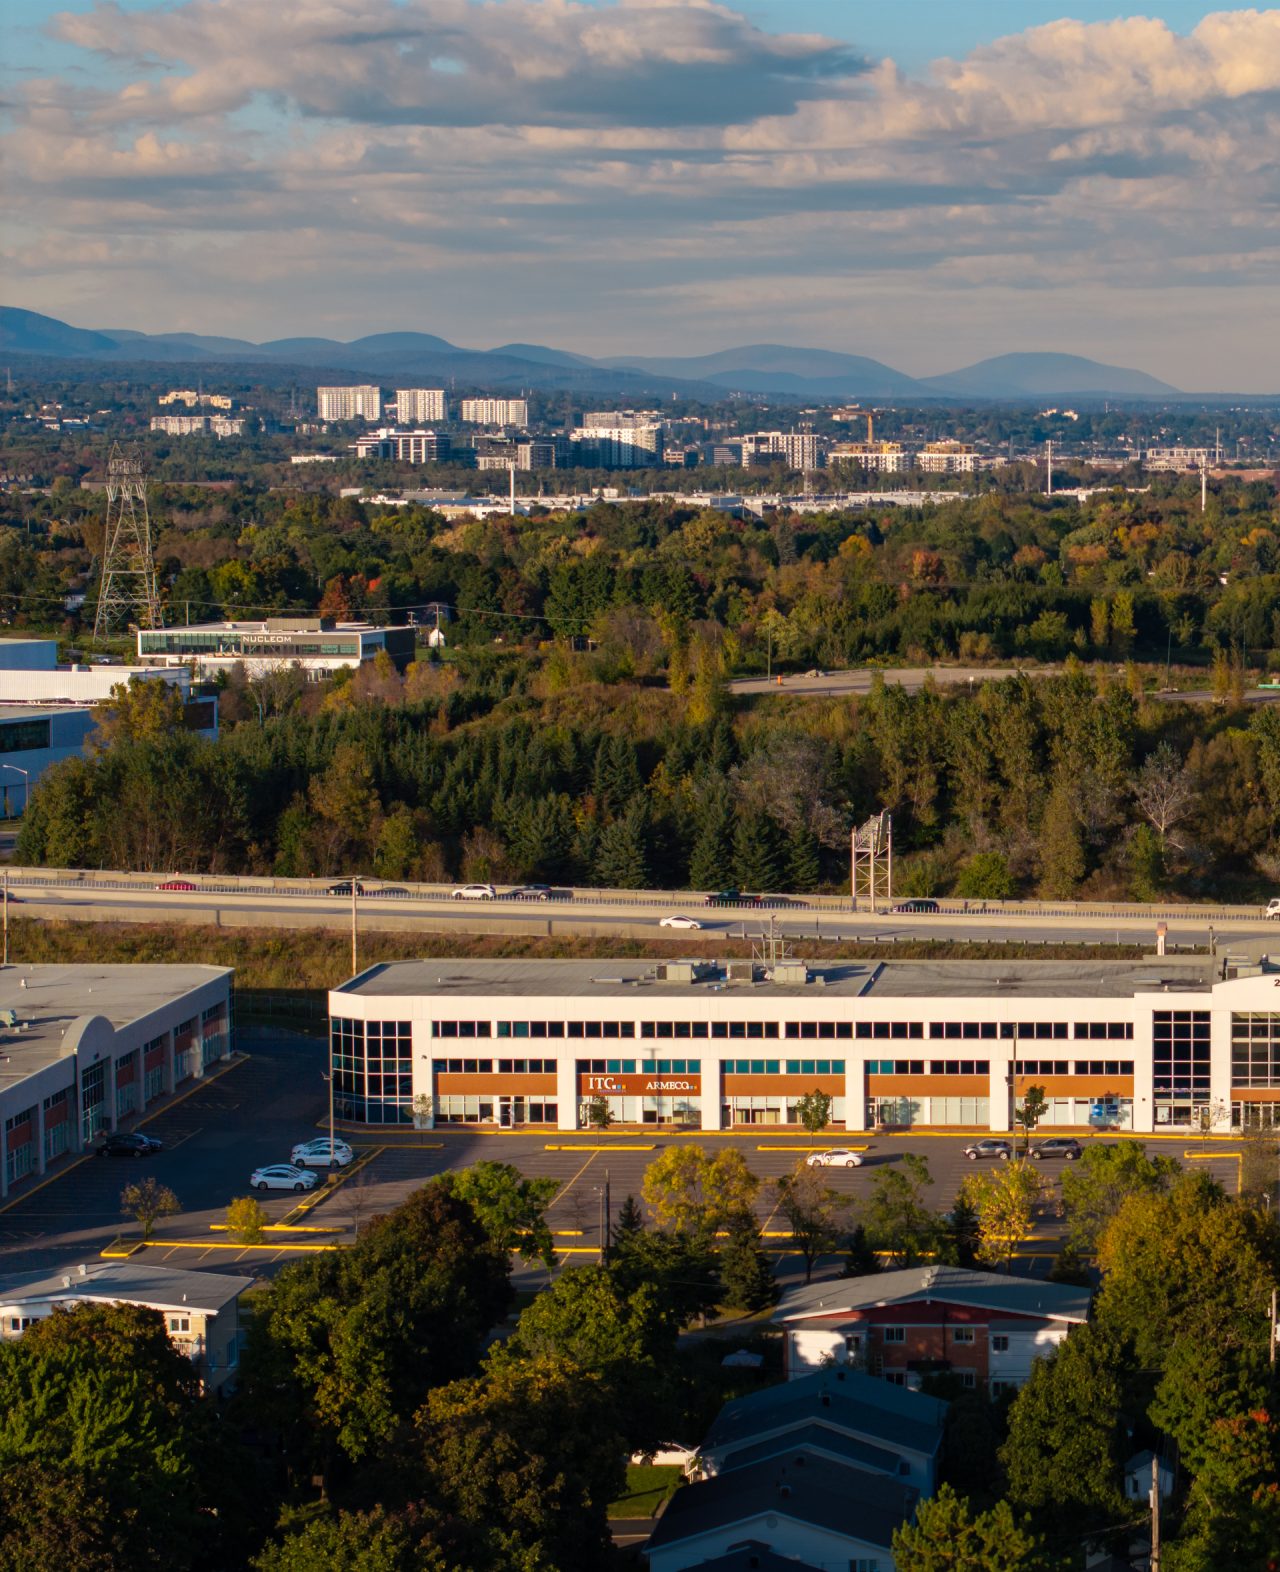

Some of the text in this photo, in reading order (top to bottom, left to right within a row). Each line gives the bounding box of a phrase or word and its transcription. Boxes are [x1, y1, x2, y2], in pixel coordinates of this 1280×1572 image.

[242, 635, 292, 643] NUCLEOM
[589, 1077, 614, 1089] ITC
[646, 1081, 690, 1090] ARMECO
